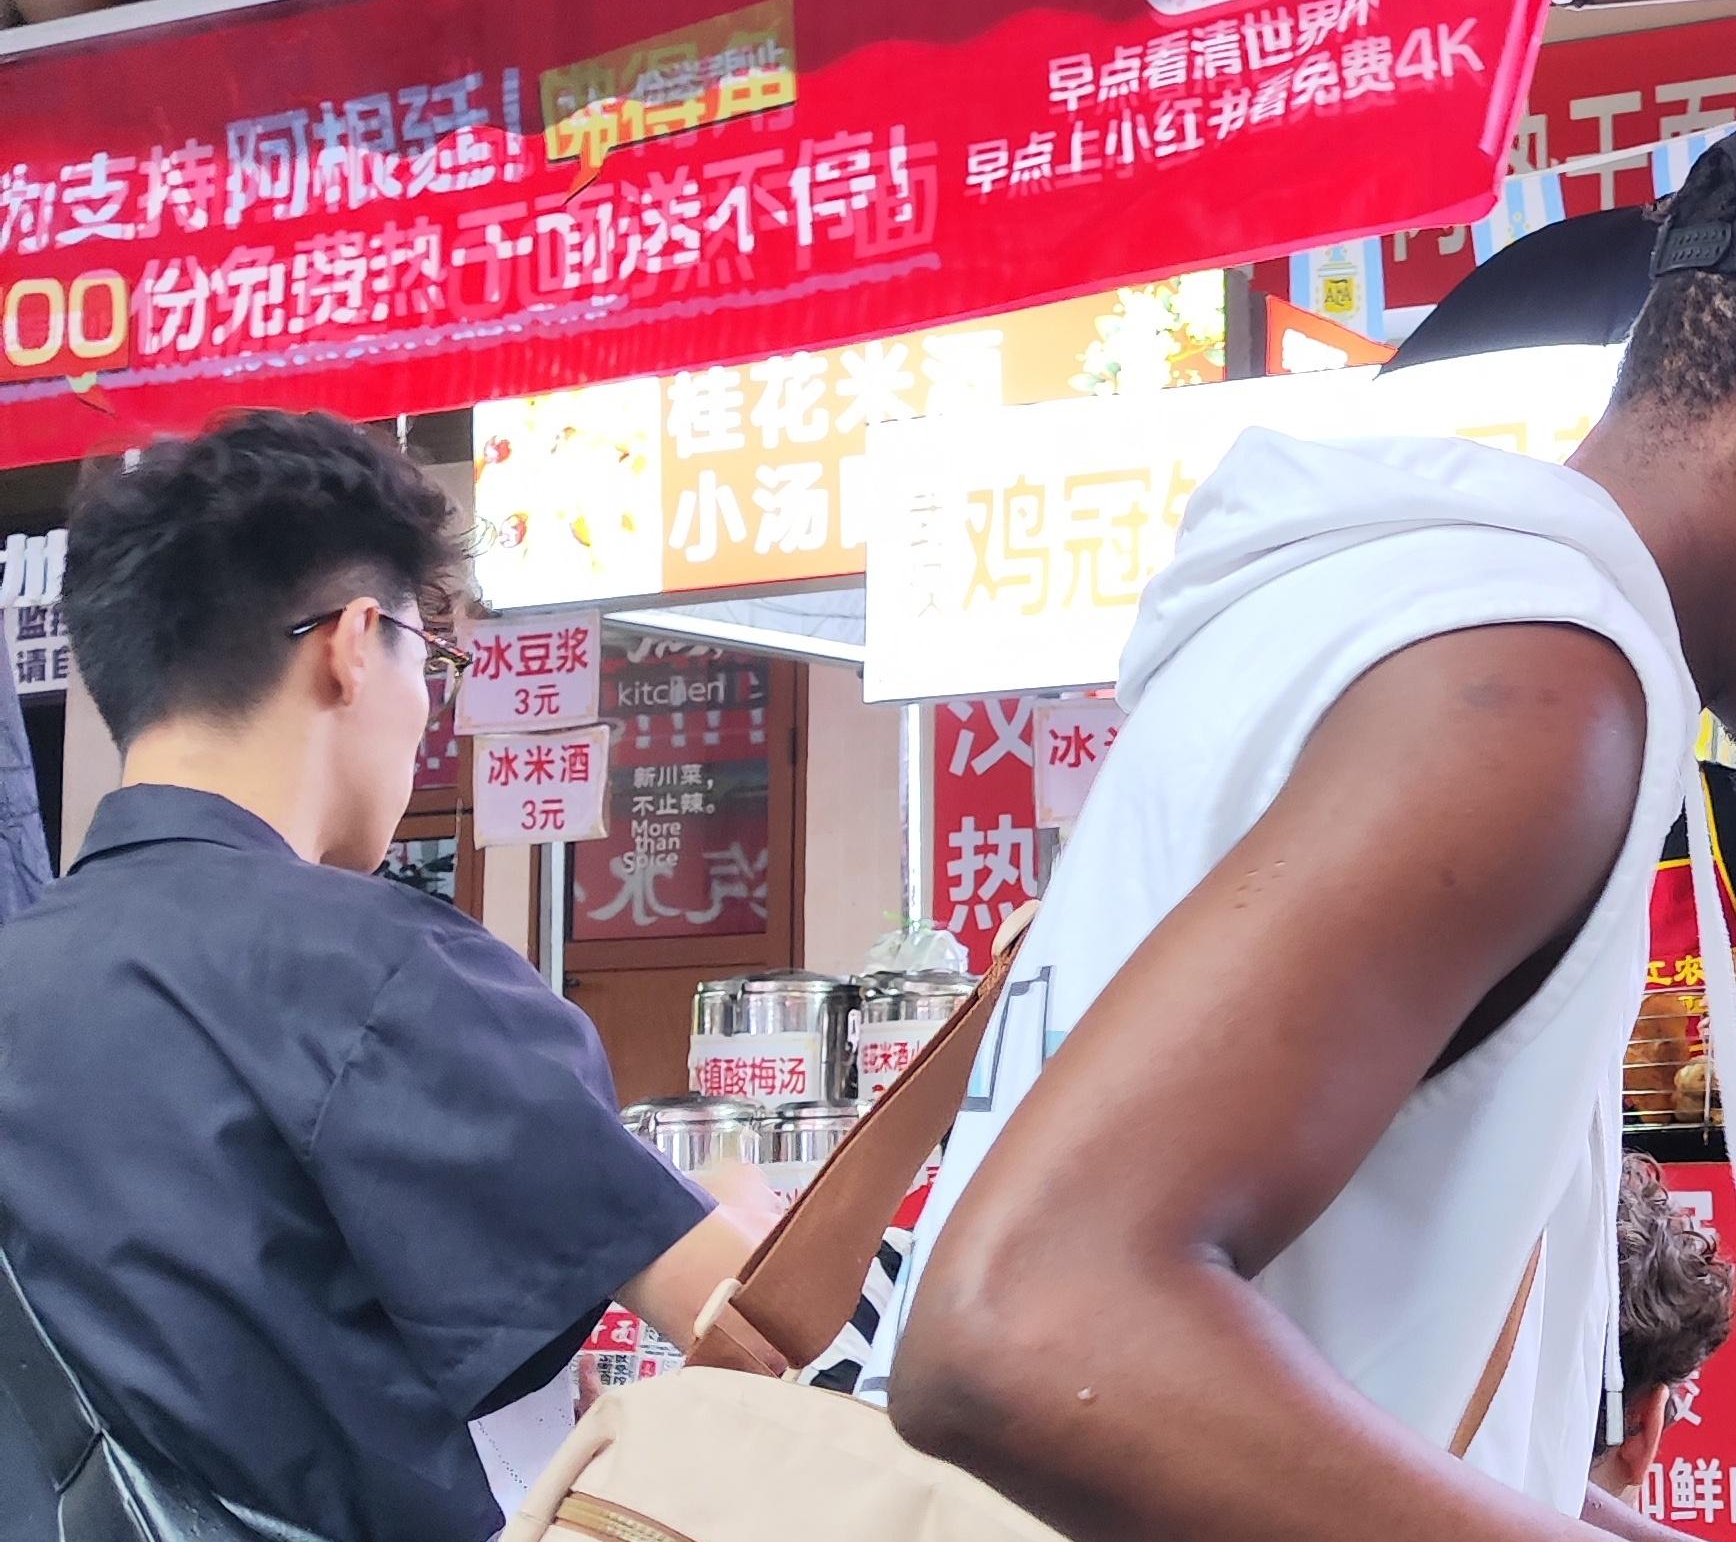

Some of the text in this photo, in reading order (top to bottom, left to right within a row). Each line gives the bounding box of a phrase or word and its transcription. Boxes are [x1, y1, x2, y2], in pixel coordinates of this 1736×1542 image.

[471, 626, 591, 680] 冰豆浆
[514, 683, 560, 717] 3元
[617, 672, 727, 708] kitchen
[1049, 725, 1119, 768] 冰
[487, 742, 591, 787] 冰米酒
[521, 798, 565, 831] 3元
[631, 818, 682, 837] More
[636, 835, 681, 852] than
